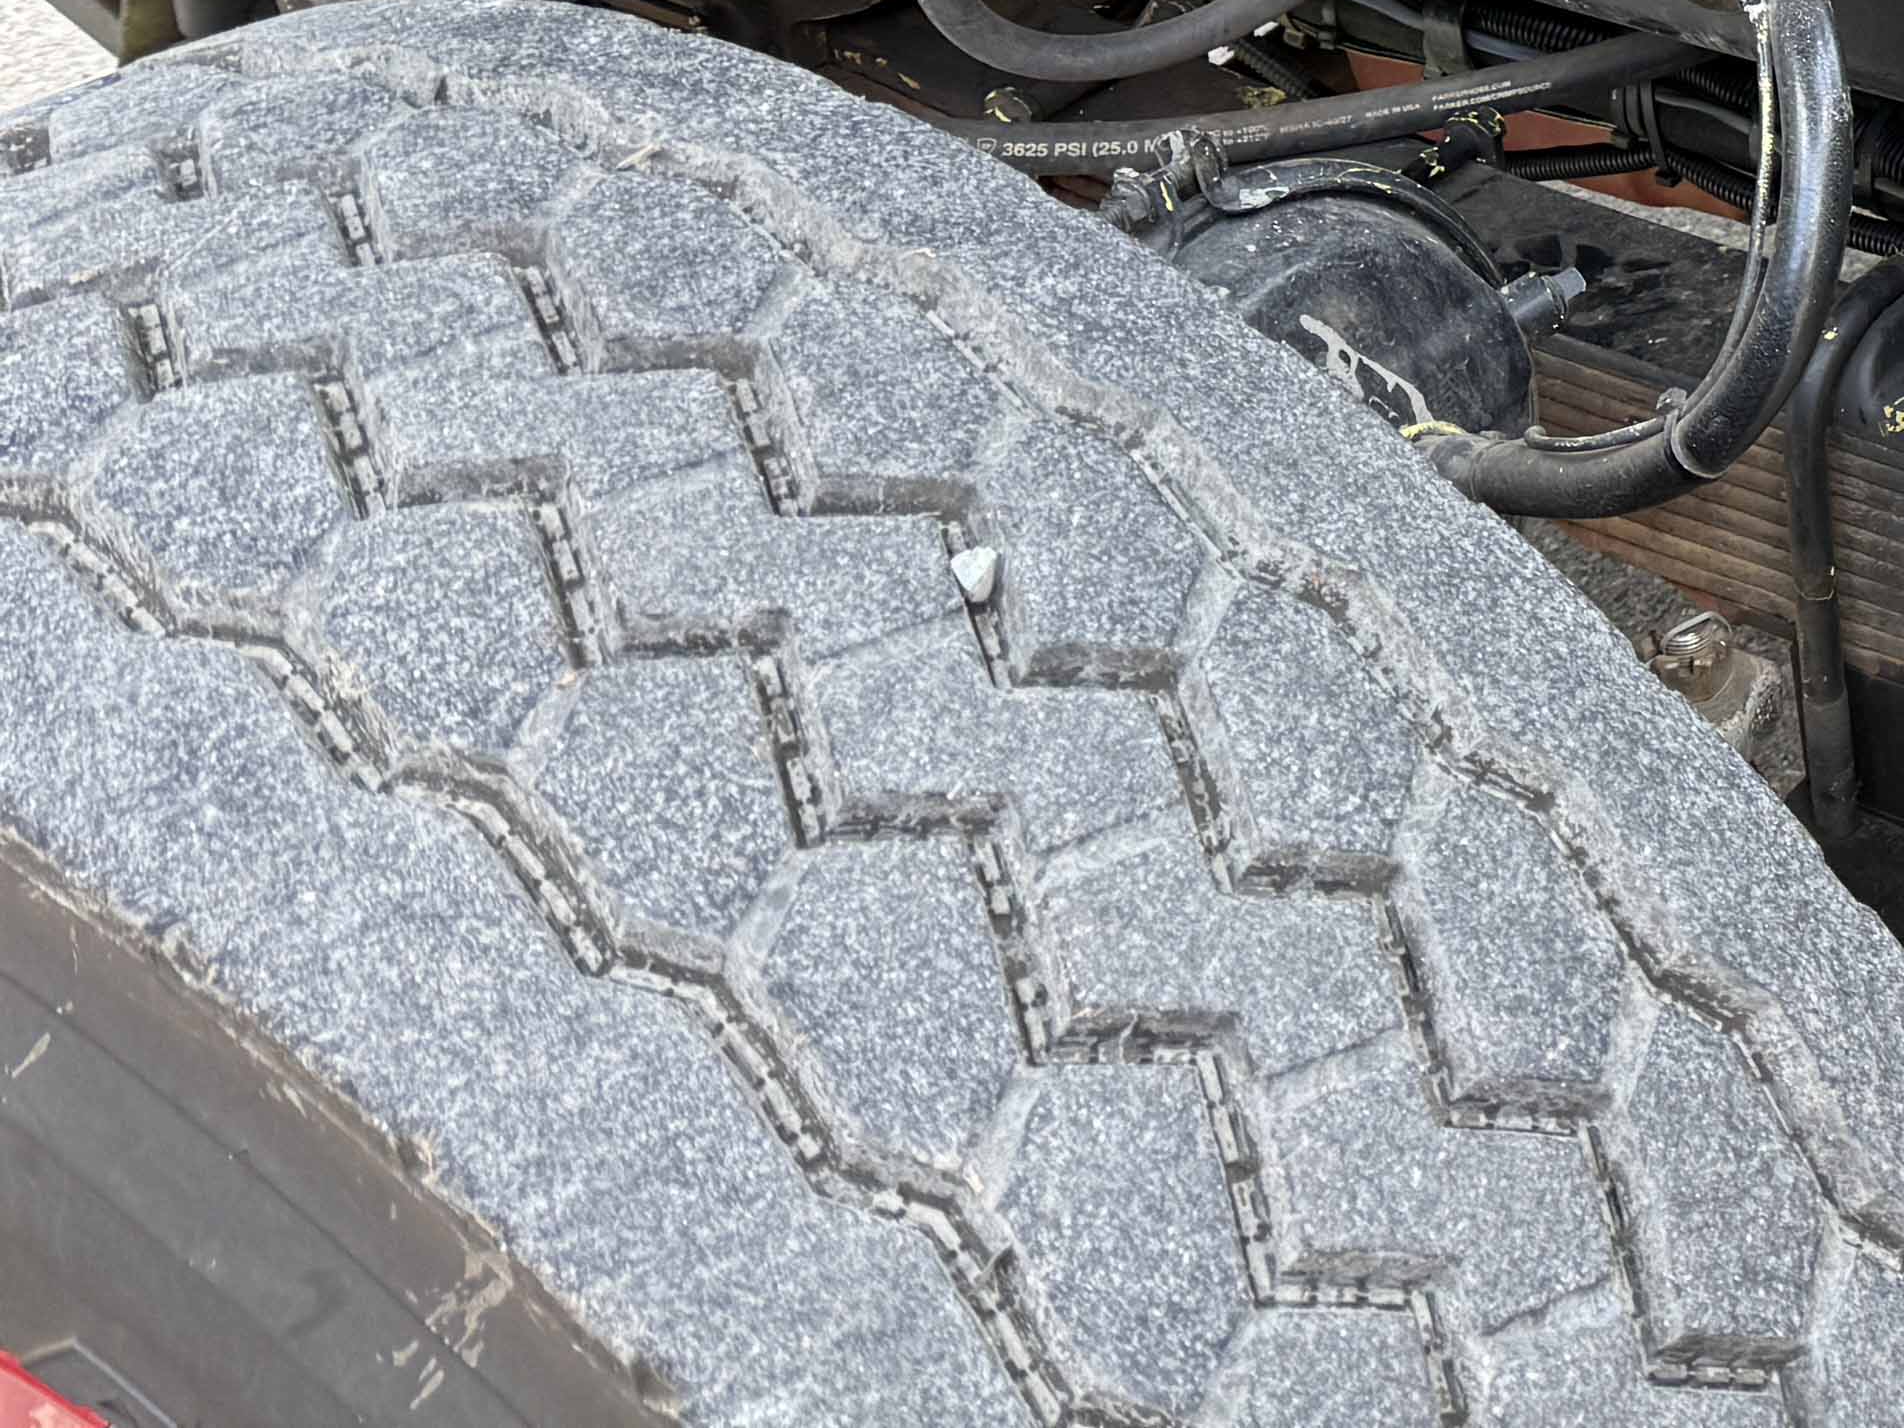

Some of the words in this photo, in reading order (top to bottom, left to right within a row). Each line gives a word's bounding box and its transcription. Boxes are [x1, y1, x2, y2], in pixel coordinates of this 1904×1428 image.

[1001, 142, 1049, 157] 3625
[1054, 142, 1087, 157] PSI
[1092, 140, 1138, 157] (25.0
